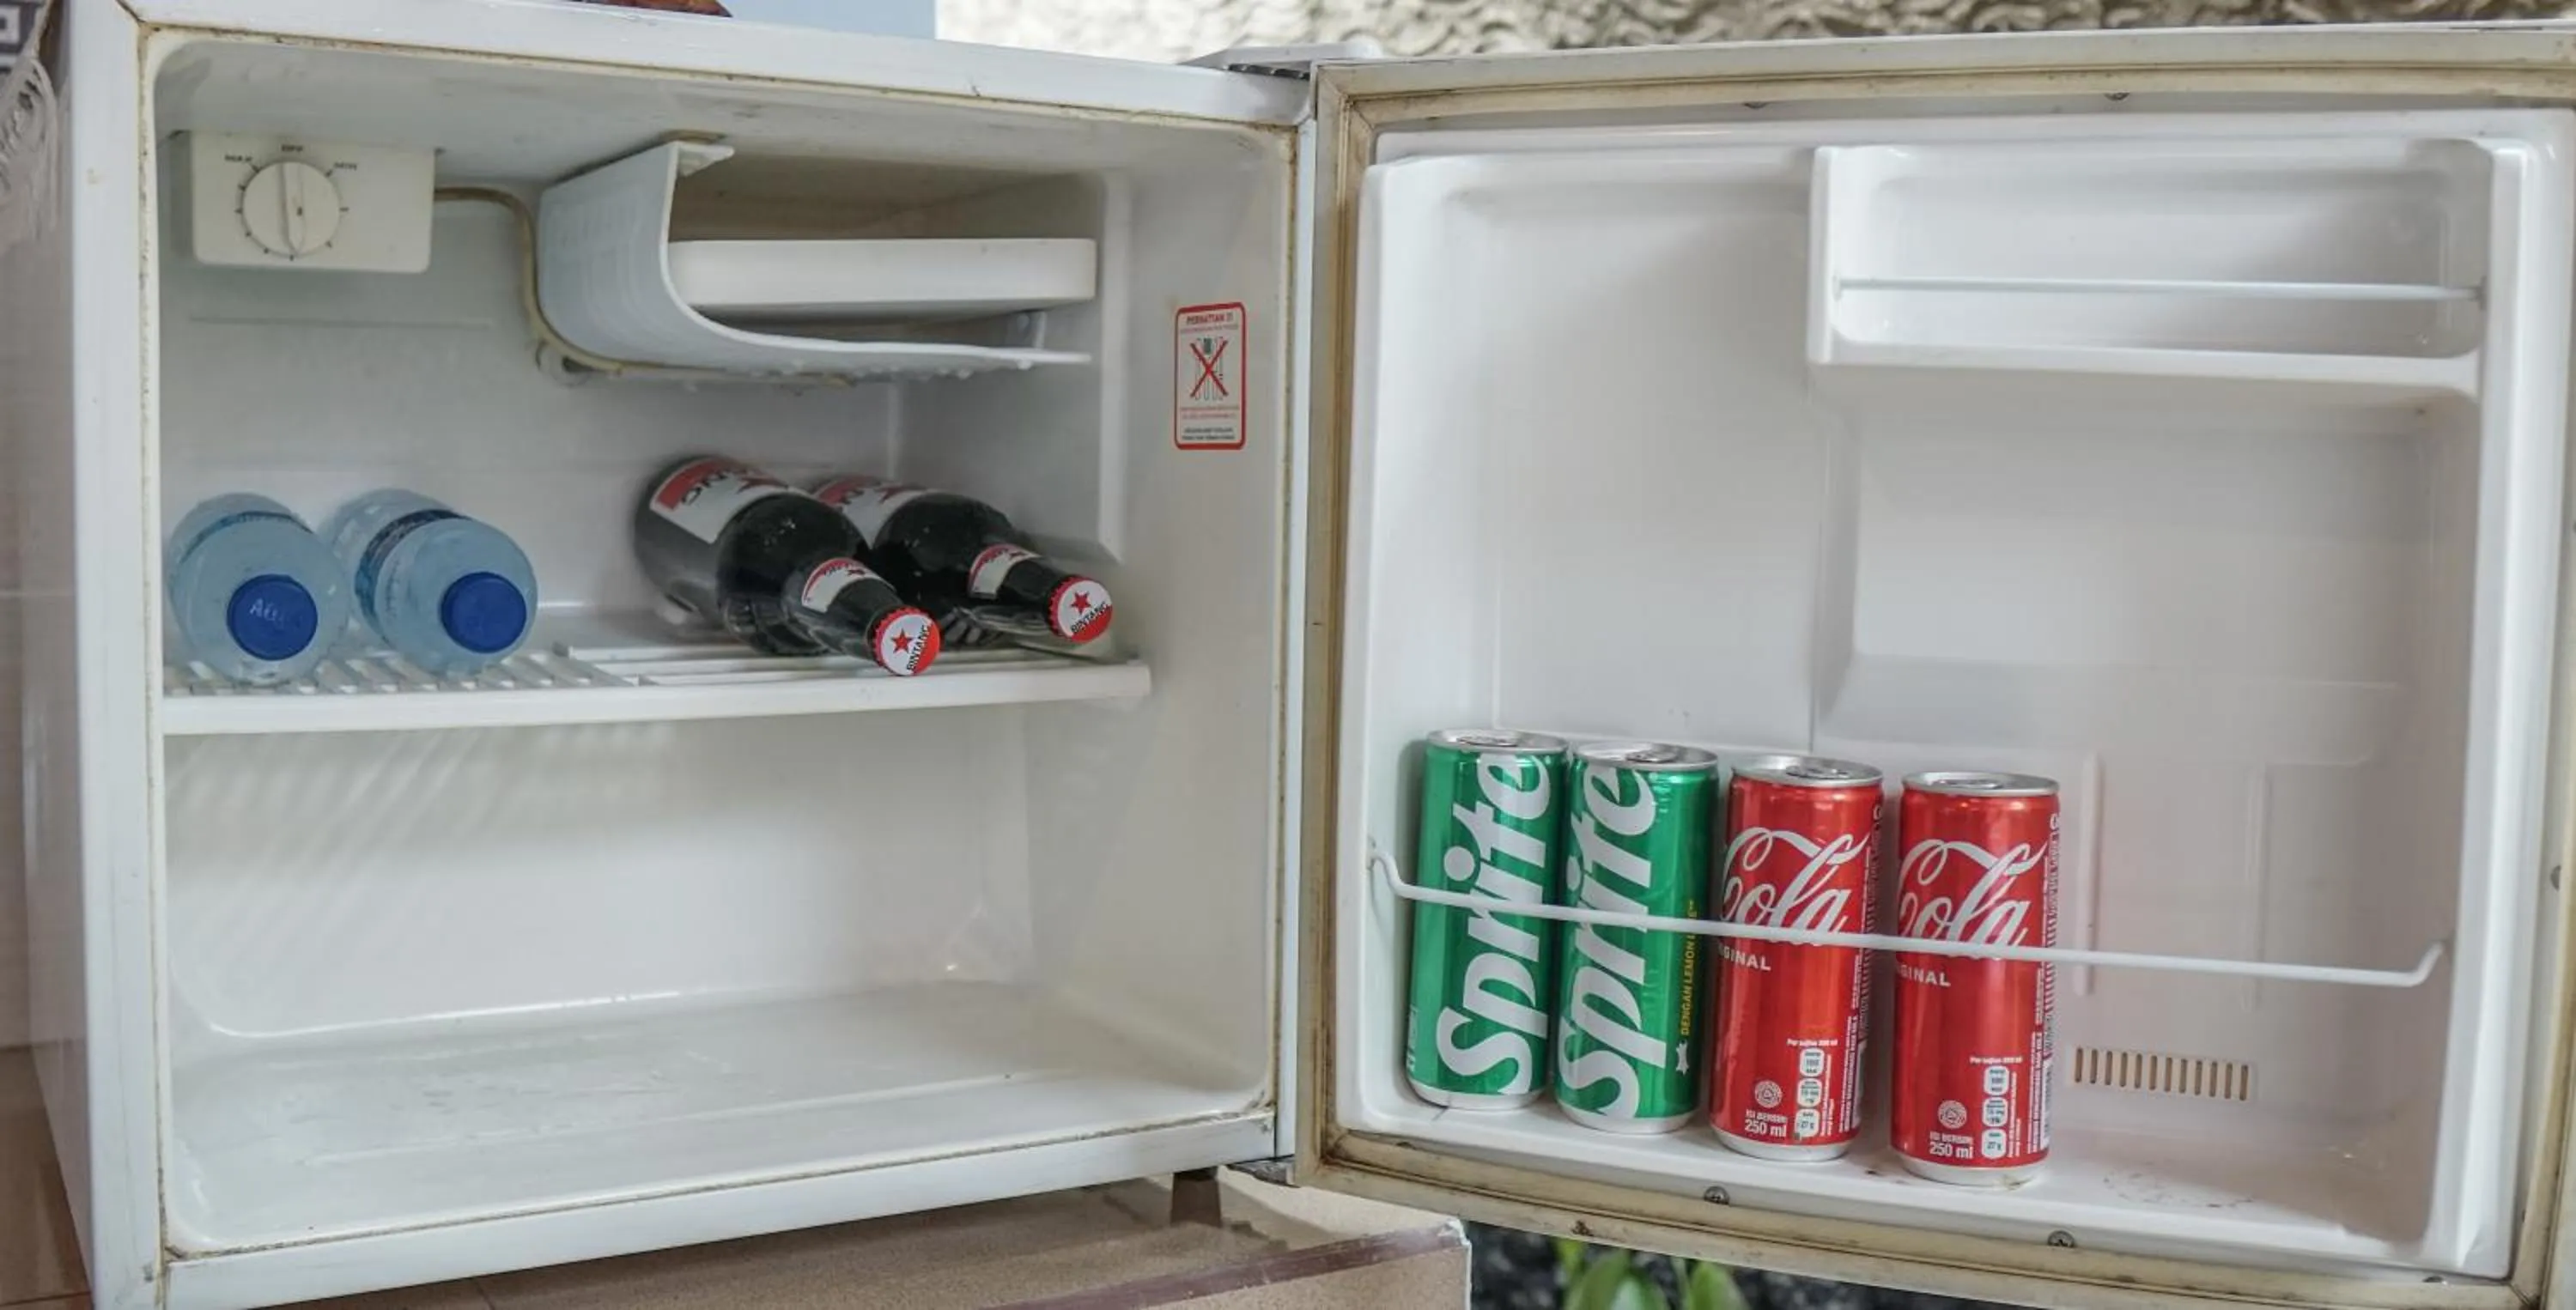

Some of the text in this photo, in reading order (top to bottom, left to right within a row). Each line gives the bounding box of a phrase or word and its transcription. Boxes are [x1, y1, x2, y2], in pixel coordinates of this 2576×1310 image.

[1071, 601, 1106, 634] BINTANG
[906, 624, 930, 670] BINTANG
[1437, 754, 1551, 1095] Sprite
[1557, 766, 1668, 1119] Sprite
[1684, 942, 1696, 984] LEMON
[1745, 1119, 1787, 1137] 250 ml
[1929, 1141, 1974, 1159] 250 ml
